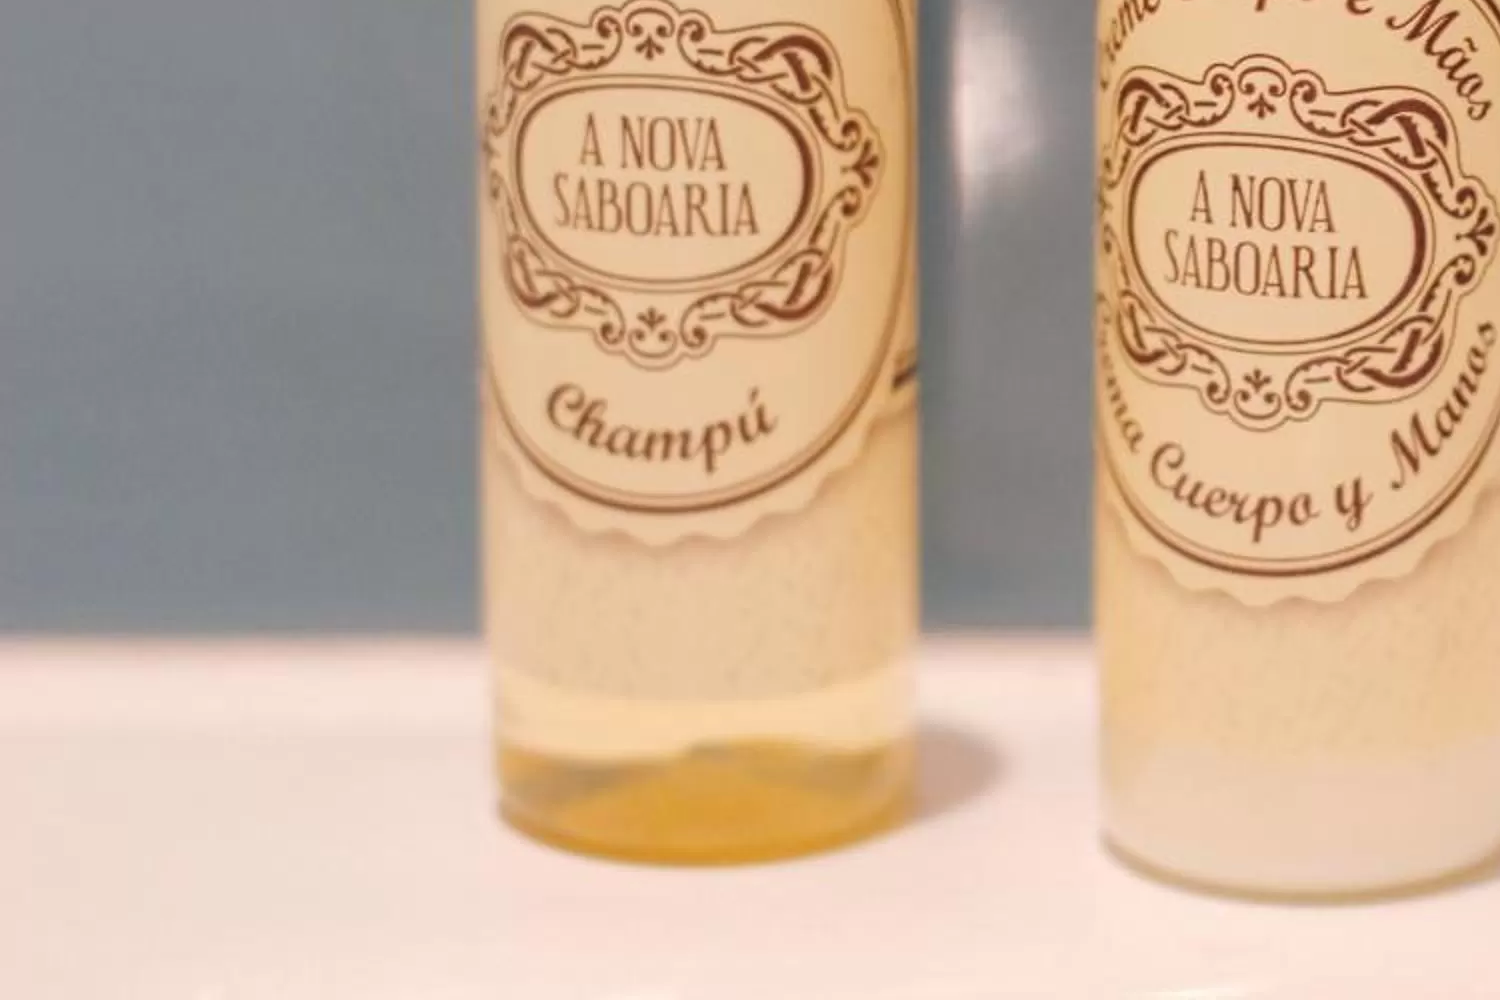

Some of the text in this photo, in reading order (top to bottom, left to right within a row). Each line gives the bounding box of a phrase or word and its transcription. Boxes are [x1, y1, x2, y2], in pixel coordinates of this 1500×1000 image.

[579, 111, 728, 172] A NOVA
[552, 171, 760, 238] SABOARIA
[1189, 169, 1338, 233] A NOVA
[1163, 228, 1370, 300] SABOARIA
[546, 382, 779, 474] Champú
[1150, 441, 1321, 544] Cuerpo
[1334, 476, 1374, 532] y
[1389, 320, 1498, 490] Manos
